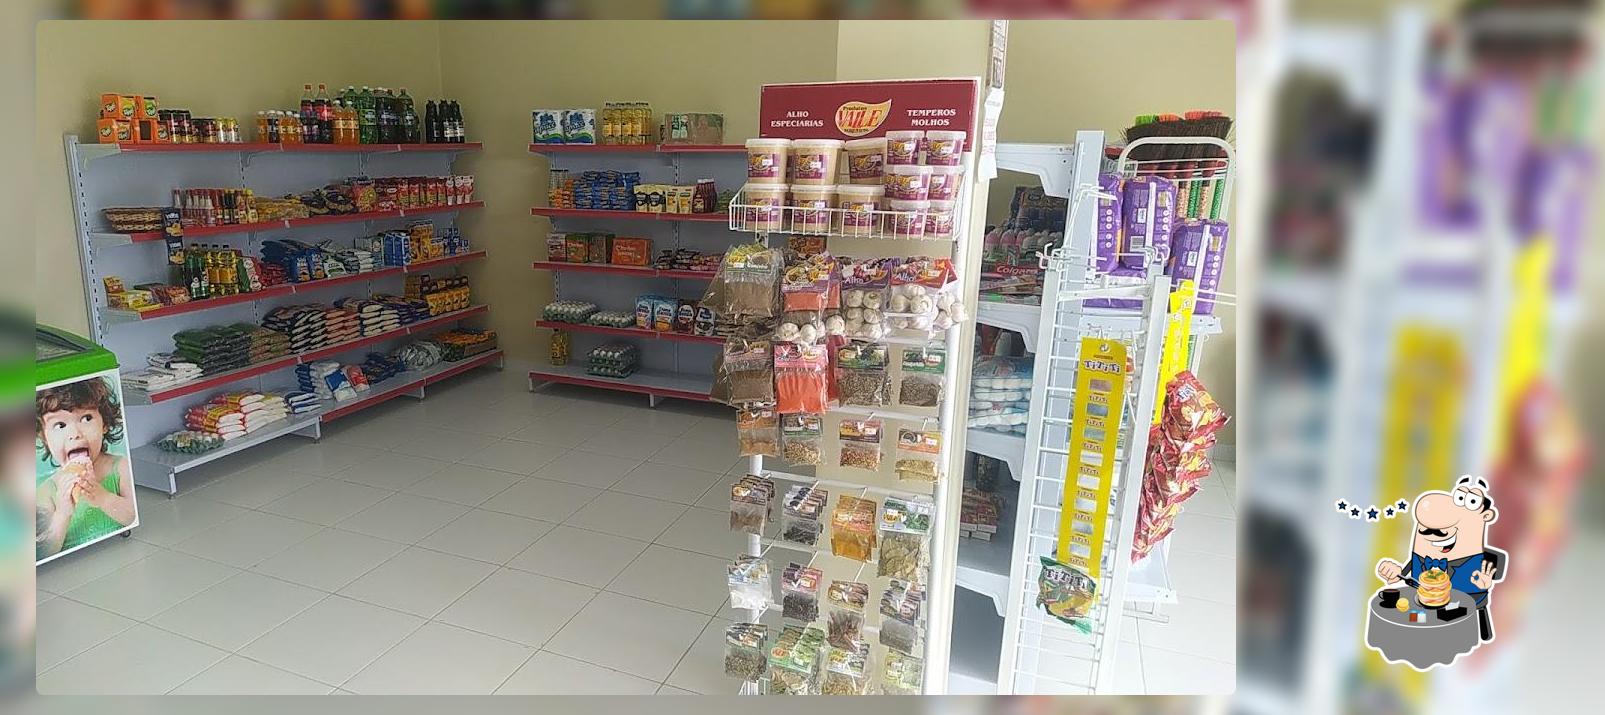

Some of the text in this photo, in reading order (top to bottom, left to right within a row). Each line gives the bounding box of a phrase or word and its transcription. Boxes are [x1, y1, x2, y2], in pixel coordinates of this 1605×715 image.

[786, 110, 809, 119] ALHO
[906, 108, 956, 117] TEMPEROS
[770, 119, 824, 127] ESPECIARIAS
[911, 118, 950, 126] MOLHOS
[843, 275, 864, 285] Alho
